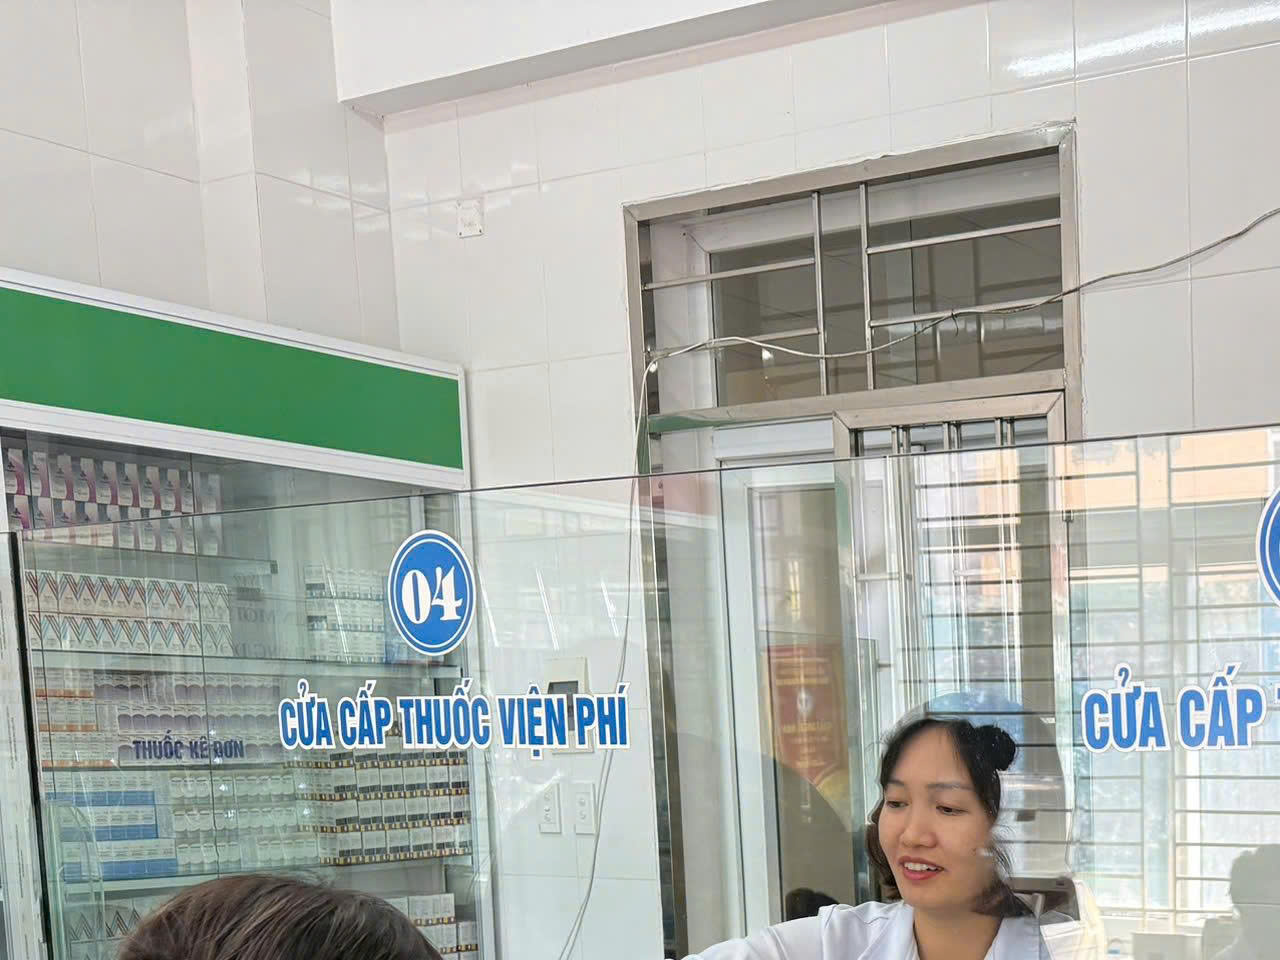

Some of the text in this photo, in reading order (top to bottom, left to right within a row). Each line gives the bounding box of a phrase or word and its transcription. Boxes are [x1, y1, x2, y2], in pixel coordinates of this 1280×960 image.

[401, 565, 464, 624] 04
[279, 678, 630, 759] CỬA CẤP THUỐC VIỆN PHÍ
[1083, 664, 1169, 753] CỬA
[1177, 663, 1266, 751] CẤP
[133, 729, 184, 759] THUỐC
